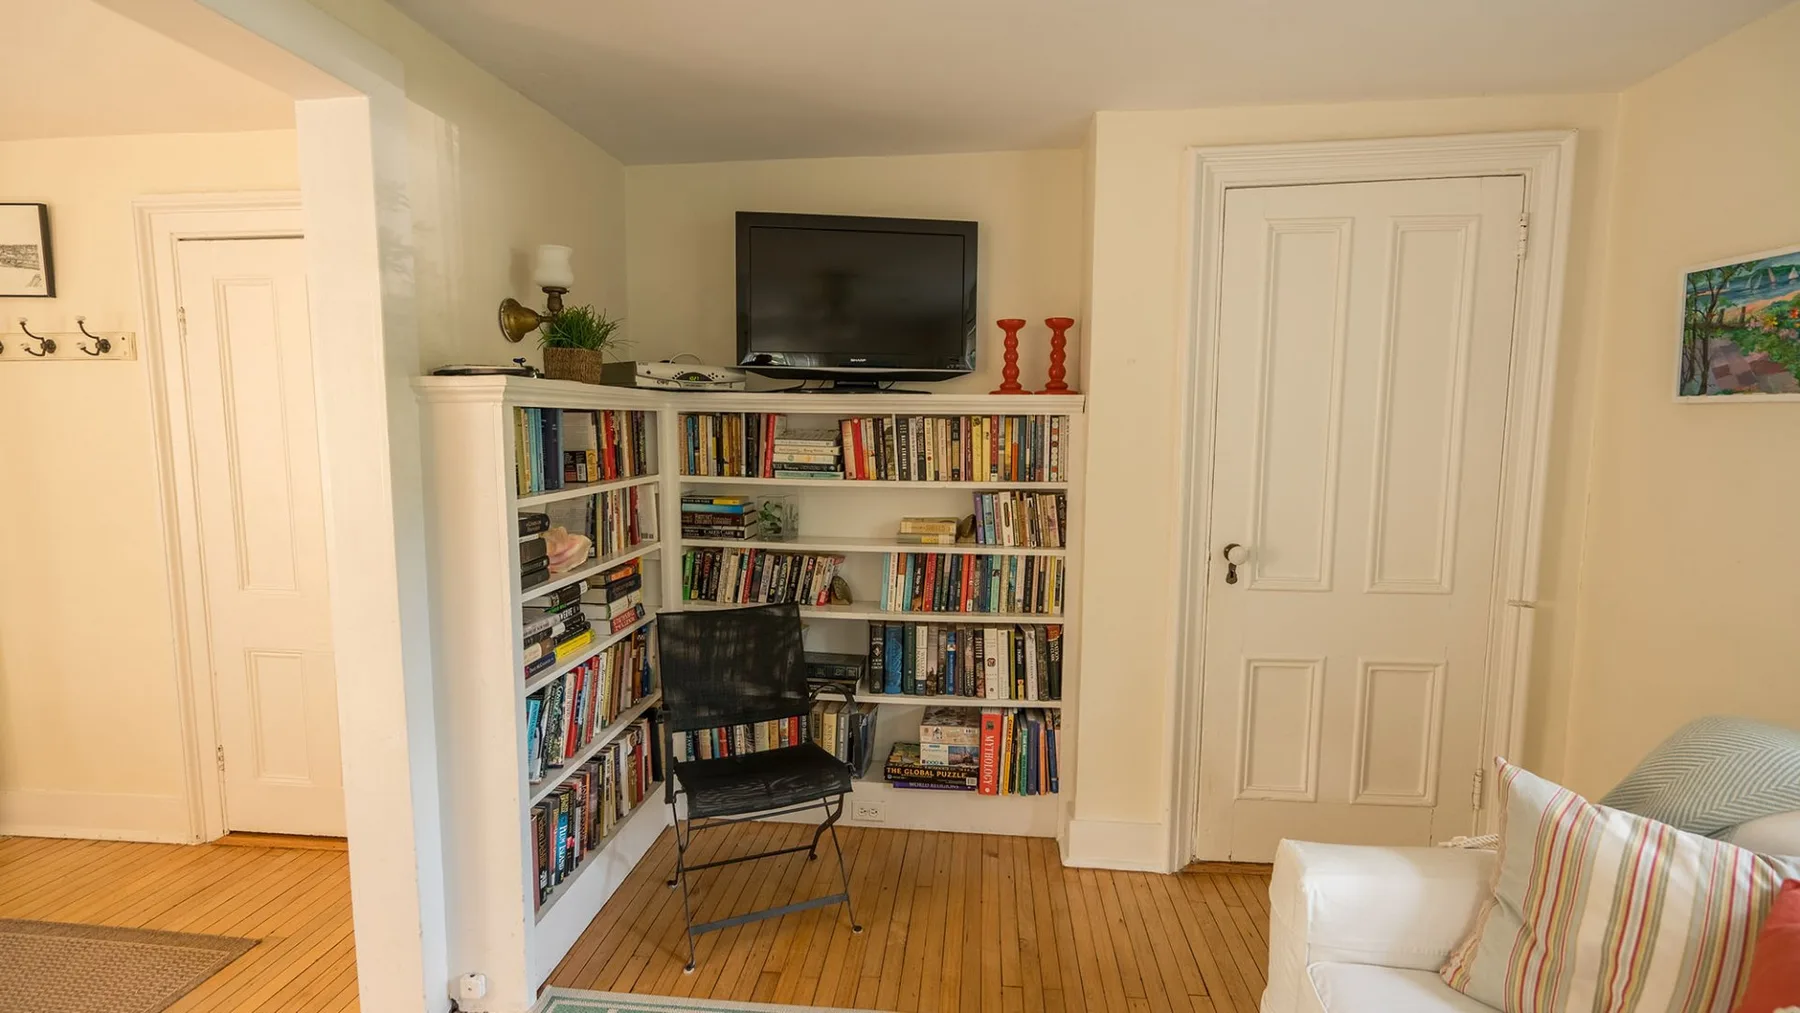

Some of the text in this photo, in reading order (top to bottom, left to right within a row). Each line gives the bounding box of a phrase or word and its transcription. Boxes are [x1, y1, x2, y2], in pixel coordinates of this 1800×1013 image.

[904, 768, 934, 777] GLOBAL
[936, 770, 967, 779] PUZZLE
[983, 735, 995, 785] MYTHOLOGY
[558, 825, 568, 871] PLUM ISLAND
